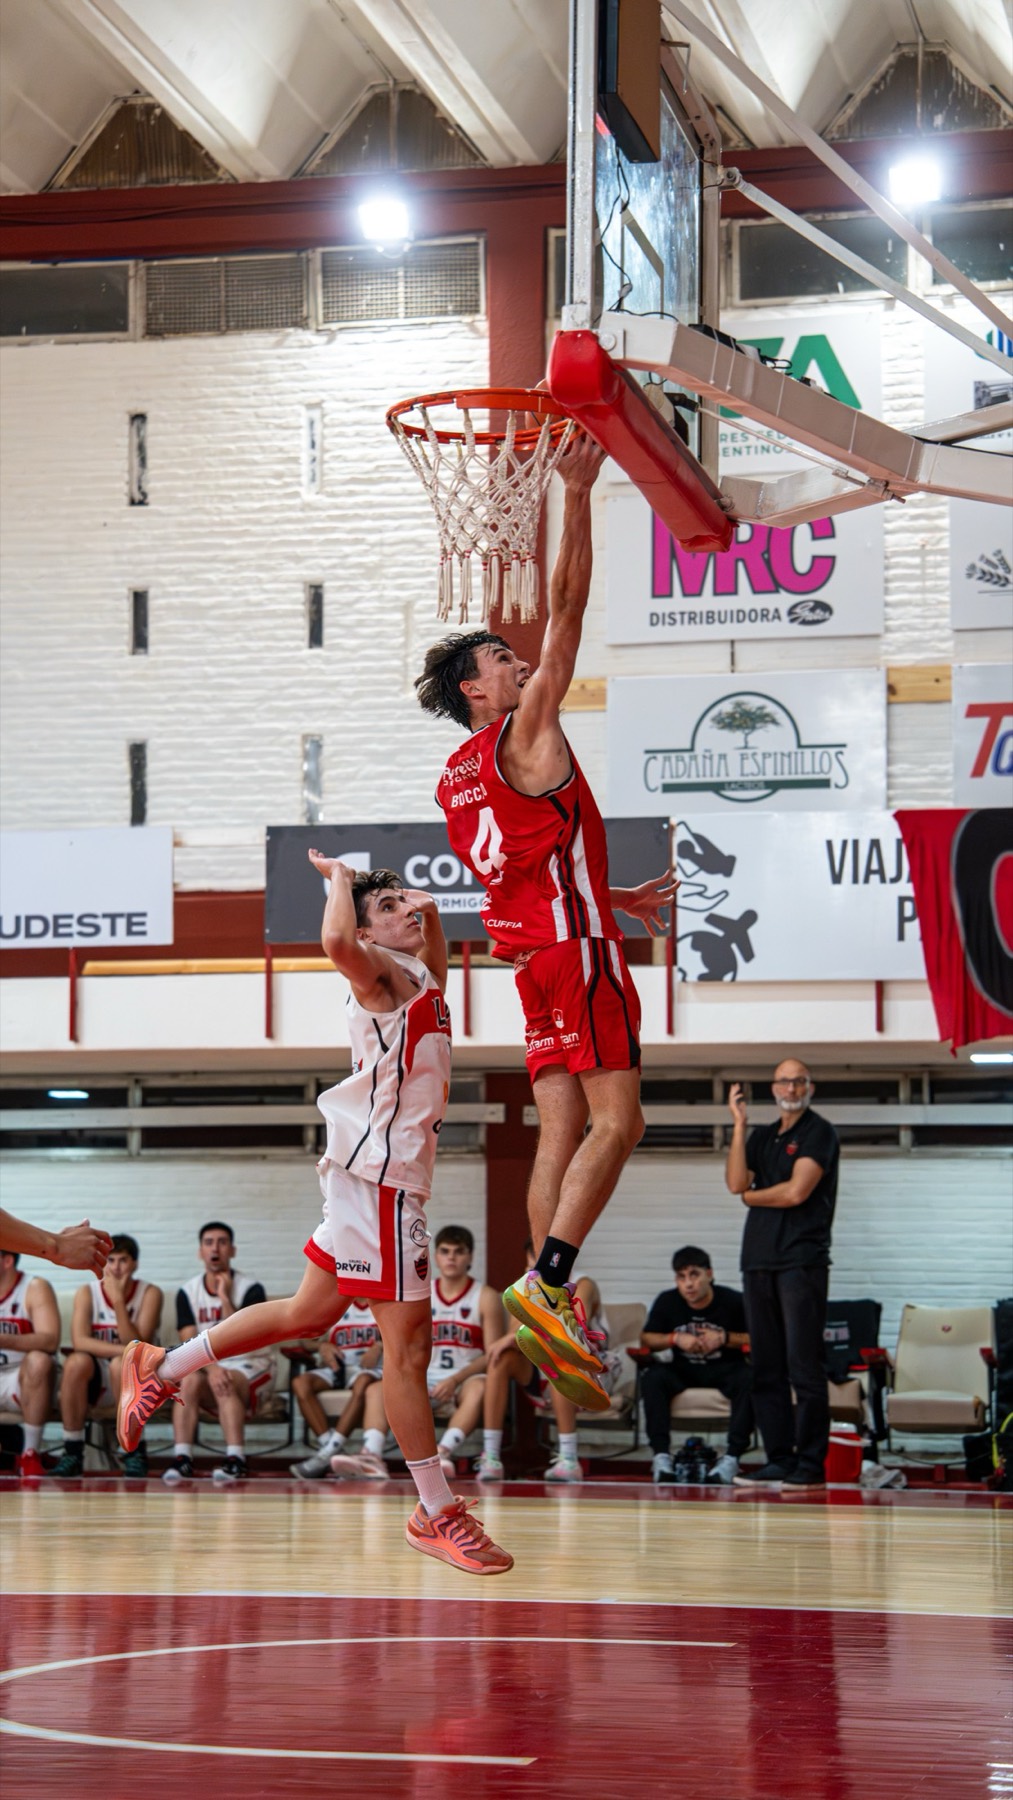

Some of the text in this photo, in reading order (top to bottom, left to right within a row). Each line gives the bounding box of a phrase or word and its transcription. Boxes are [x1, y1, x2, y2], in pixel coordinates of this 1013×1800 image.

[721, 444, 793, 457] ENTINO
[650, 512, 837, 598] MRC
[649, 607, 783, 627] DISTRIBUIDORA
[643, 749, 850, 793] CABAÑA ESPINILLOS
[470, 806, 508, 876] 4
[435, 898, 485, 908] RMIG
[0, 912, 148, 939] UDESTE
[486, 918, 523, 928] CUFFIA
[336, 1262, 371, 1274] ORVEN
[440, 1350, 455, 1370] 5
